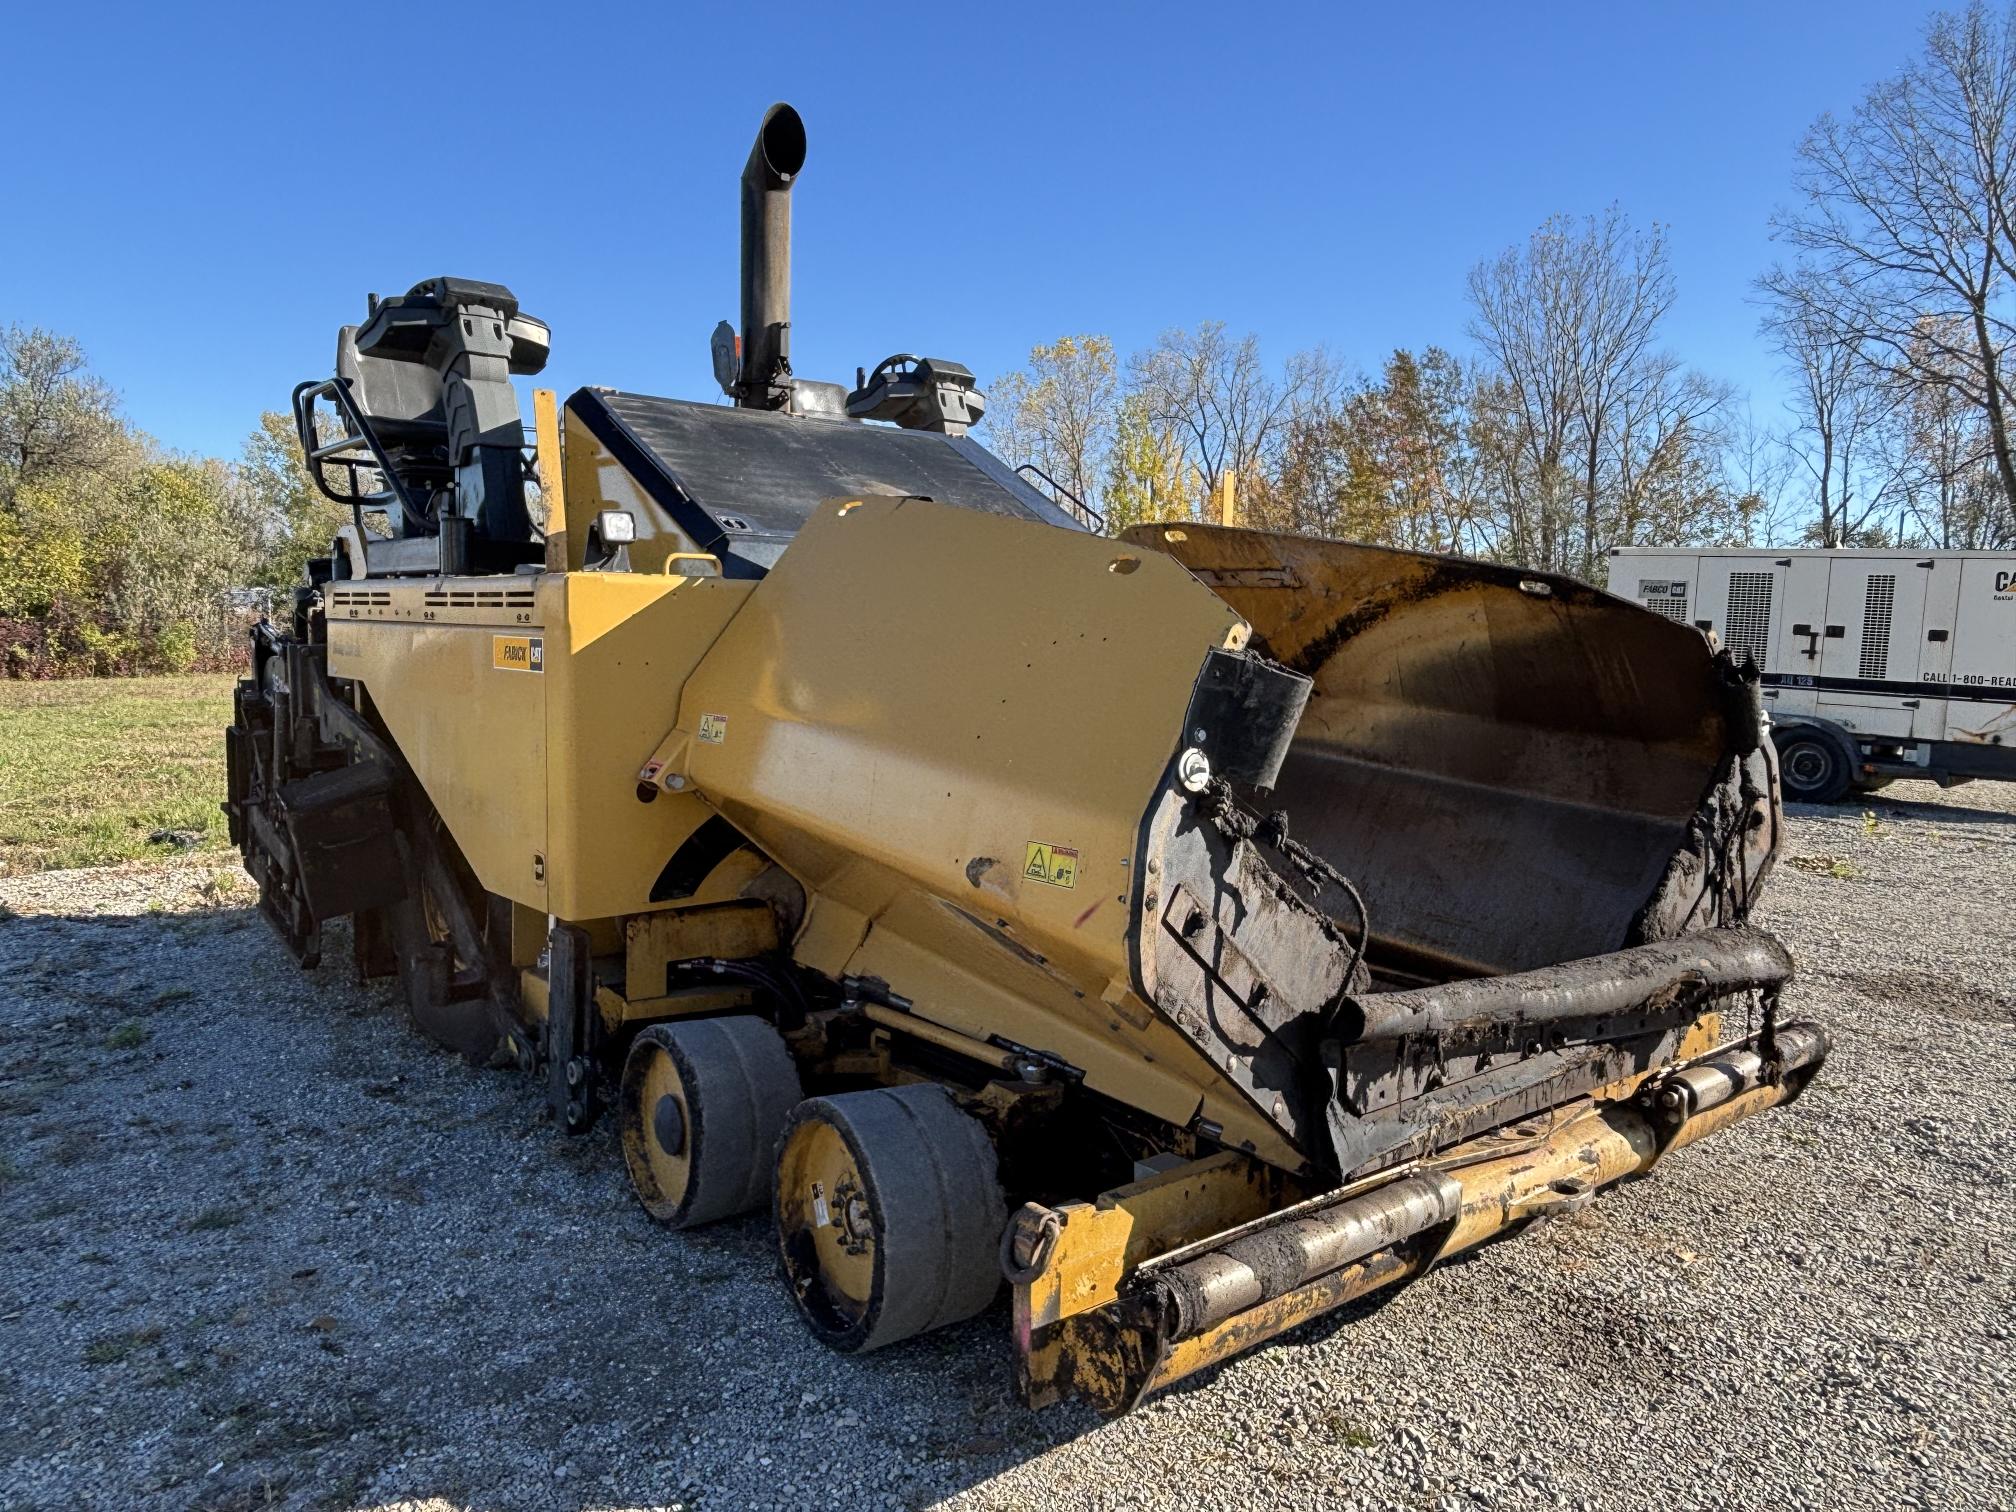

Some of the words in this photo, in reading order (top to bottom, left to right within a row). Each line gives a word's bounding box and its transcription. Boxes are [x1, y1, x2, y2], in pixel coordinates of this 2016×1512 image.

[1671, 586, 1685, 594] CAT
[503, 645, 527, 662] FABICK
[530, 646, 542, 663] CAT
[1923, 672, 1947, 682] CALL
